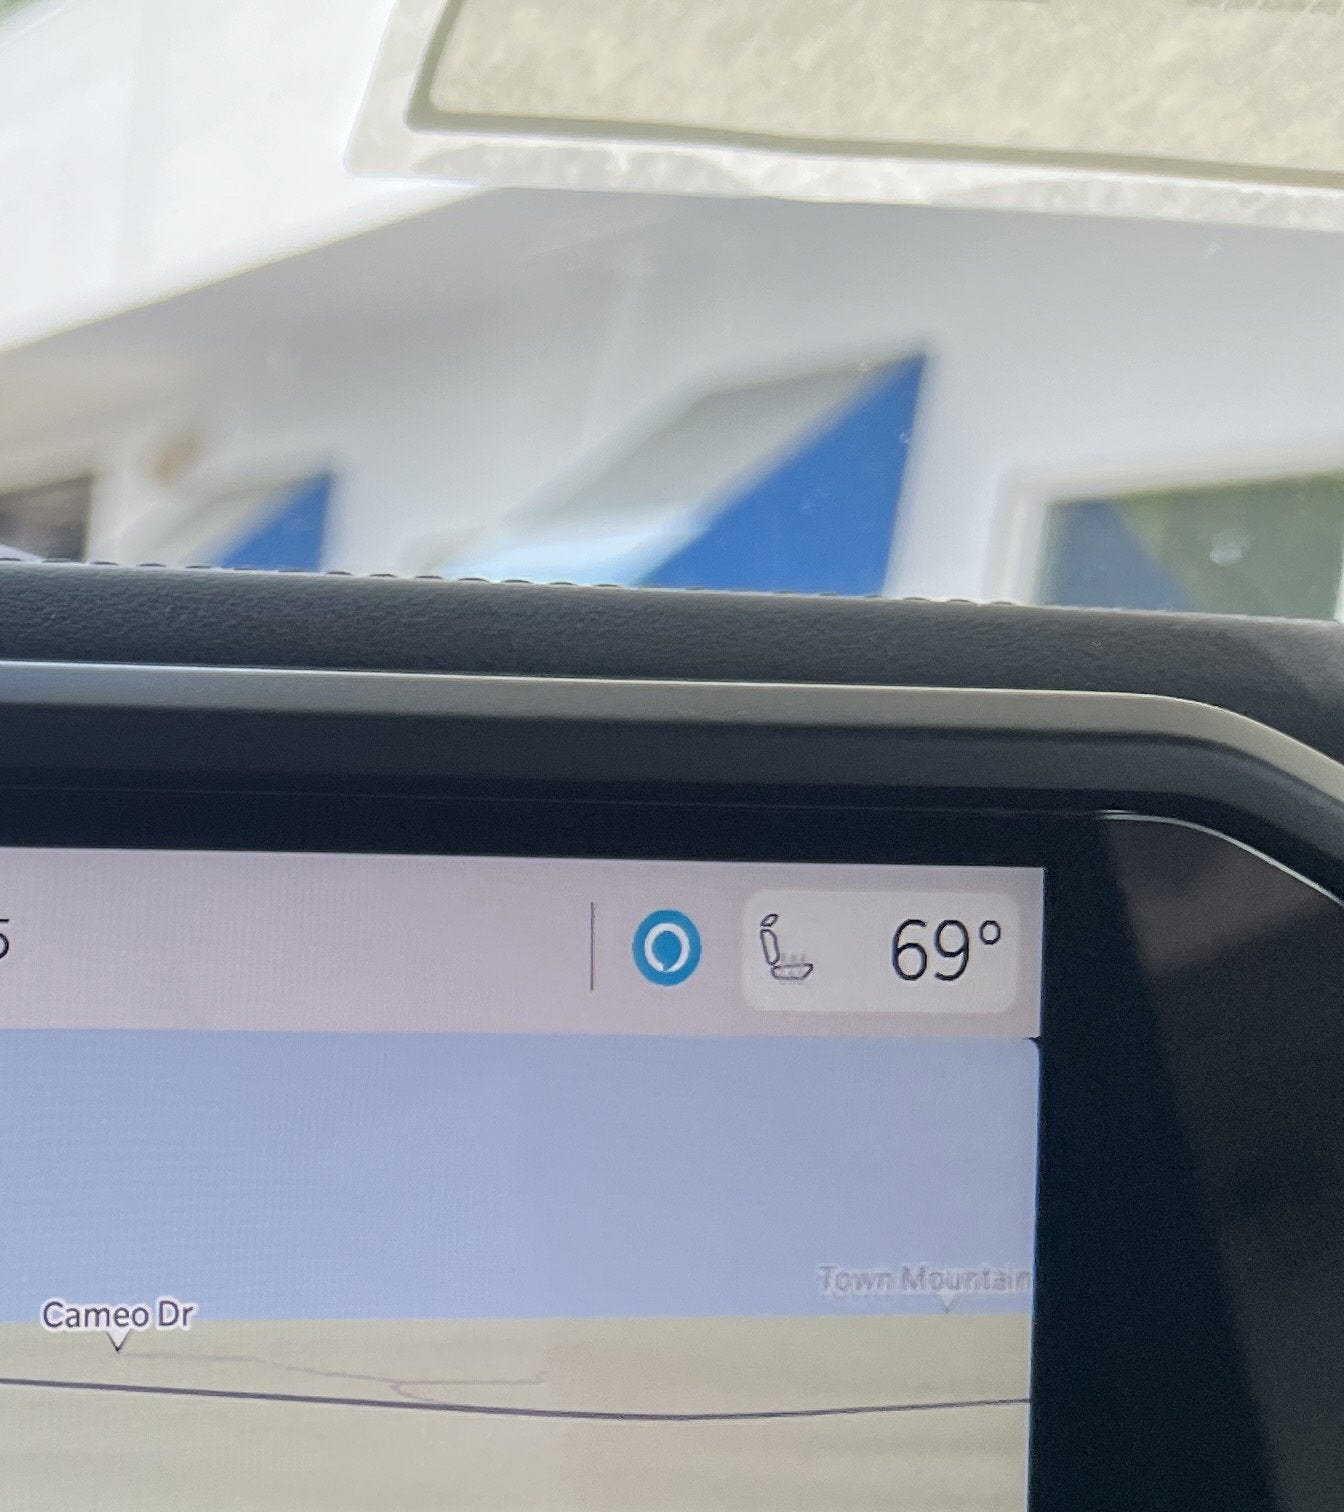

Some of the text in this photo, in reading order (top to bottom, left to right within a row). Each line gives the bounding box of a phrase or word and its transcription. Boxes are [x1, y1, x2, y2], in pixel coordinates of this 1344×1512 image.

[819, 1265, 894, 1291] Town
[41, 1300, 195, 1331] Cameo Dr
